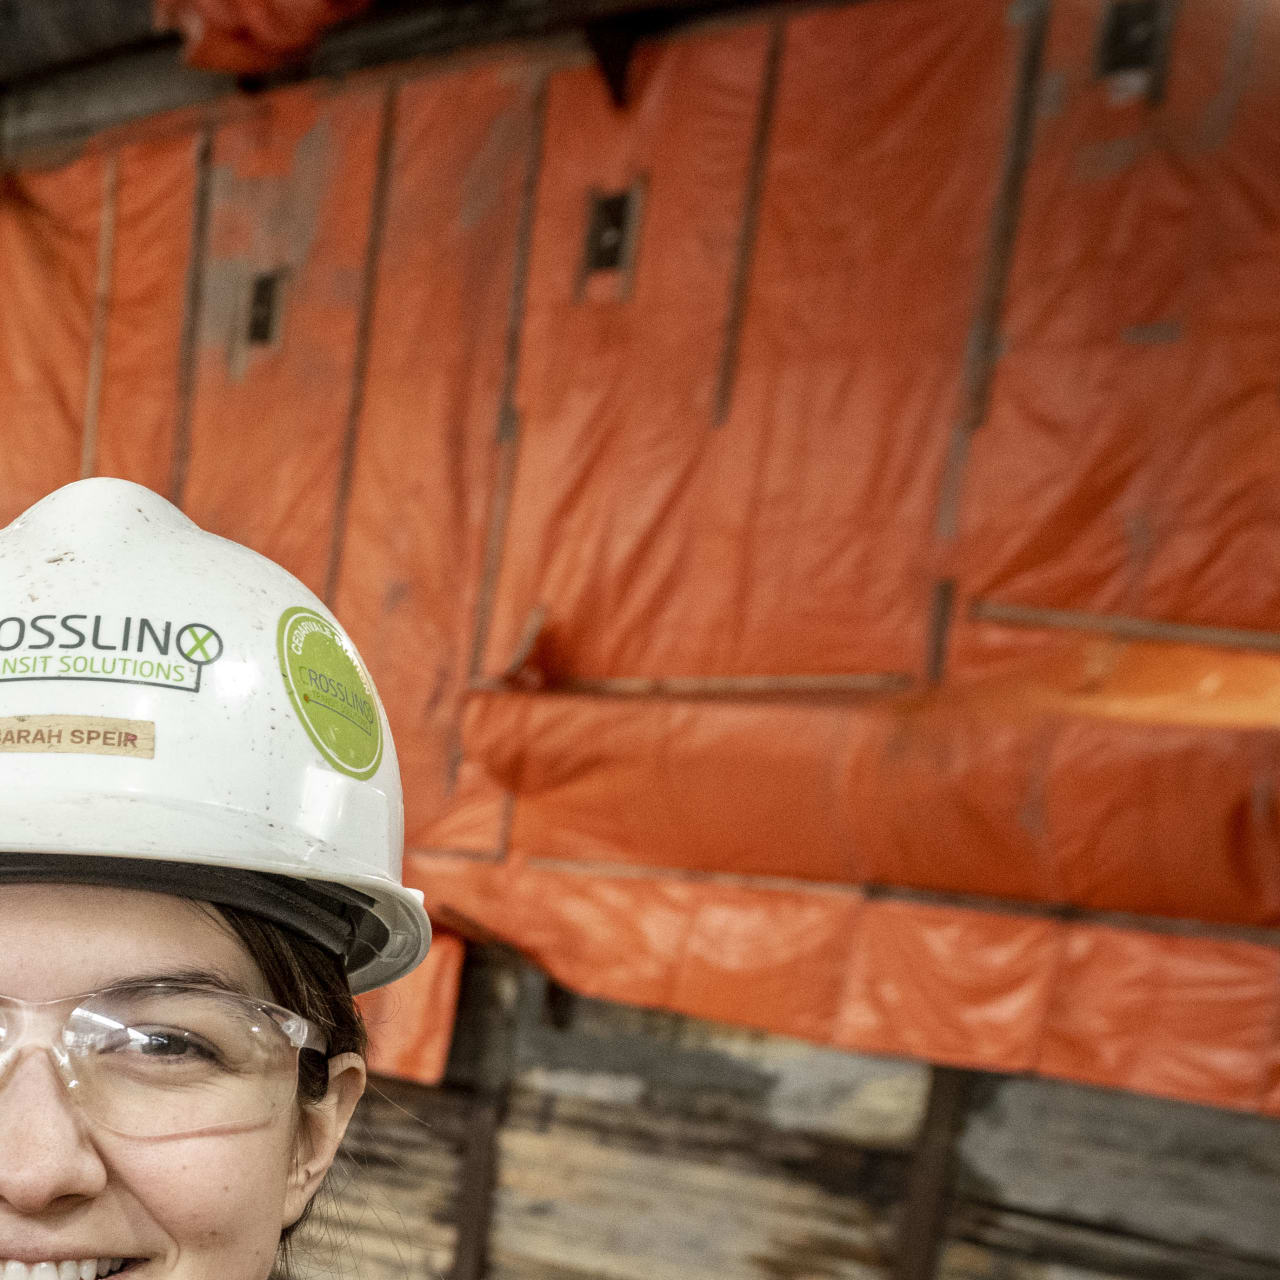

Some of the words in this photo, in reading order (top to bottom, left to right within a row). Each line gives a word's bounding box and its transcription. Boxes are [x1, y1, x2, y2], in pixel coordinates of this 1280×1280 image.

[291, 621, 334, 656] CEDARVALE
[60, 656, 187, 683] SOLUTIONS
[70, 729, 138, 748] SPEIR
